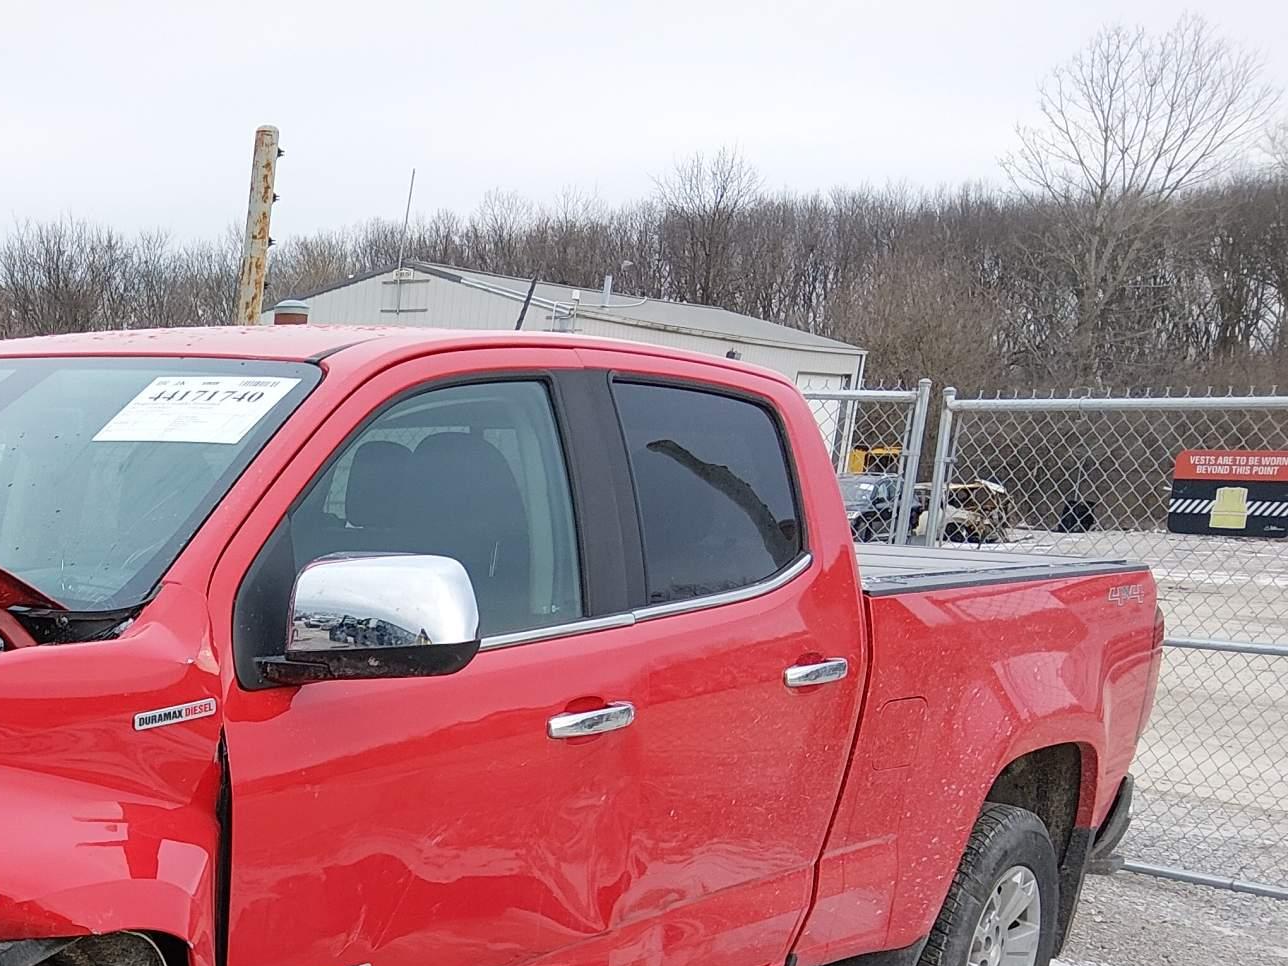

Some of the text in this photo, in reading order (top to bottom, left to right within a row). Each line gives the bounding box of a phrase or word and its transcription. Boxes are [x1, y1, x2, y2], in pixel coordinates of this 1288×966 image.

[148, 390, 265, 402] 44171740
[1190, 455, 1288, 467] VESTS ARE TO BE WORN
[1196, 465, 1279, 475] BEYOND THIS POINT
[138, 703, 213, 726] DURAMAX DIESEL
